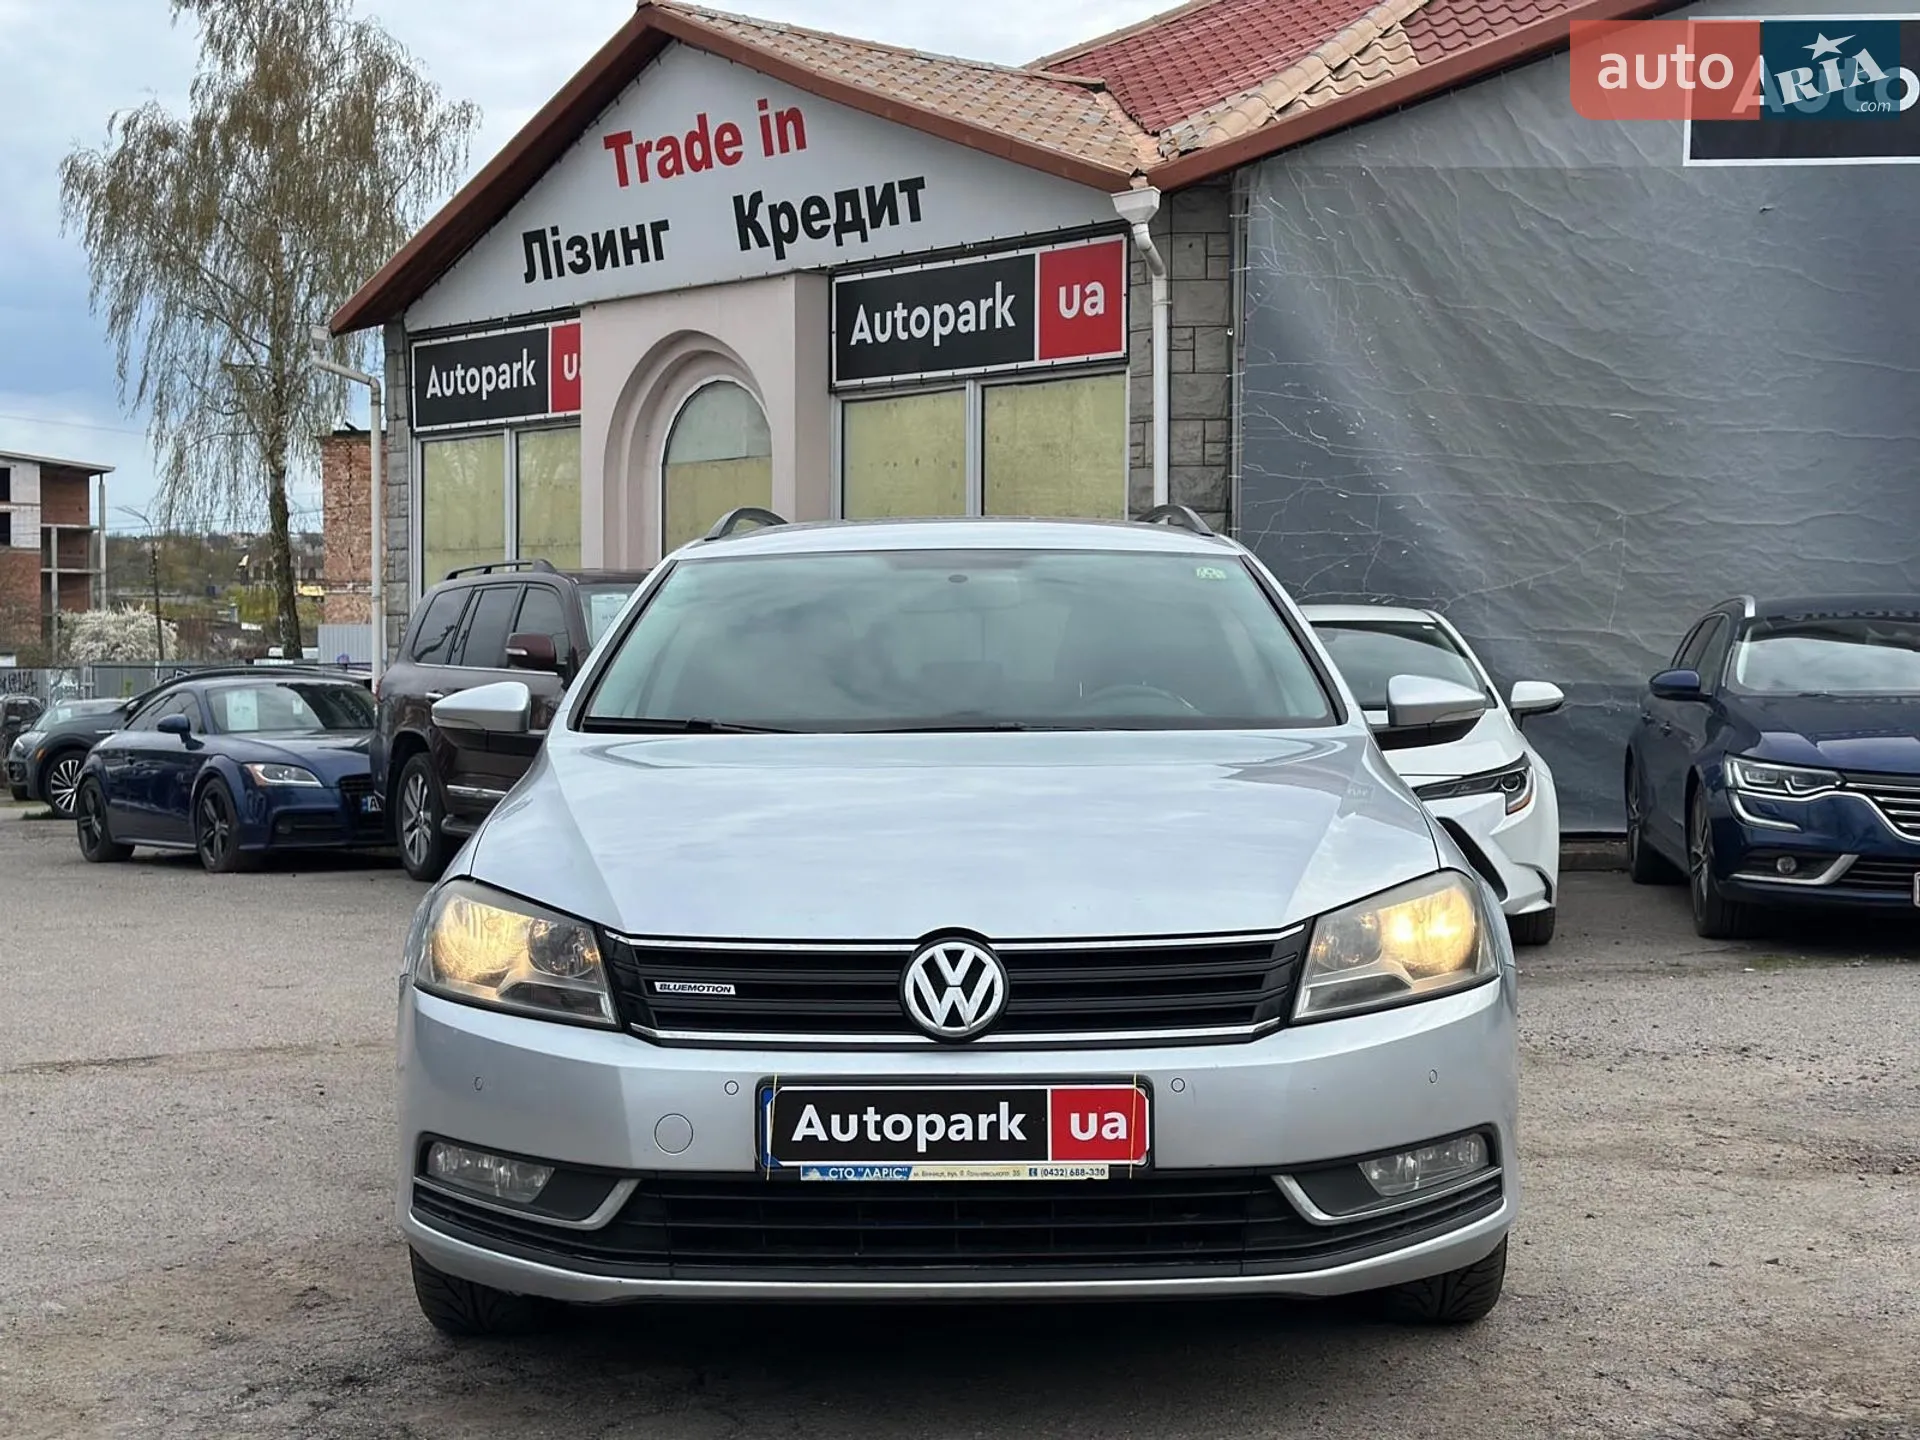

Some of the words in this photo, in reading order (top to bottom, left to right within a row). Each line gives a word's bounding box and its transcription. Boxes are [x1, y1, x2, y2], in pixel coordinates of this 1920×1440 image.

[603, 112, 744, 188] Trade
[757, 98, 807, 158] in
[522, 218, 670, 283] Лізинг
[732, 175, 926, 261] Кредит
[850, 280, 1016, 347] Autopark
[1058, 280, 1106, 320] ua
[426, 348, 536, 400] Autopark
[659, 983, 732, 993] BLUEMOTION
[791, 1101, 1027, 1153] Autopark
[1070, 1110, 1128, 1142] ua
[828, 1167, 855, 1179] СТО
